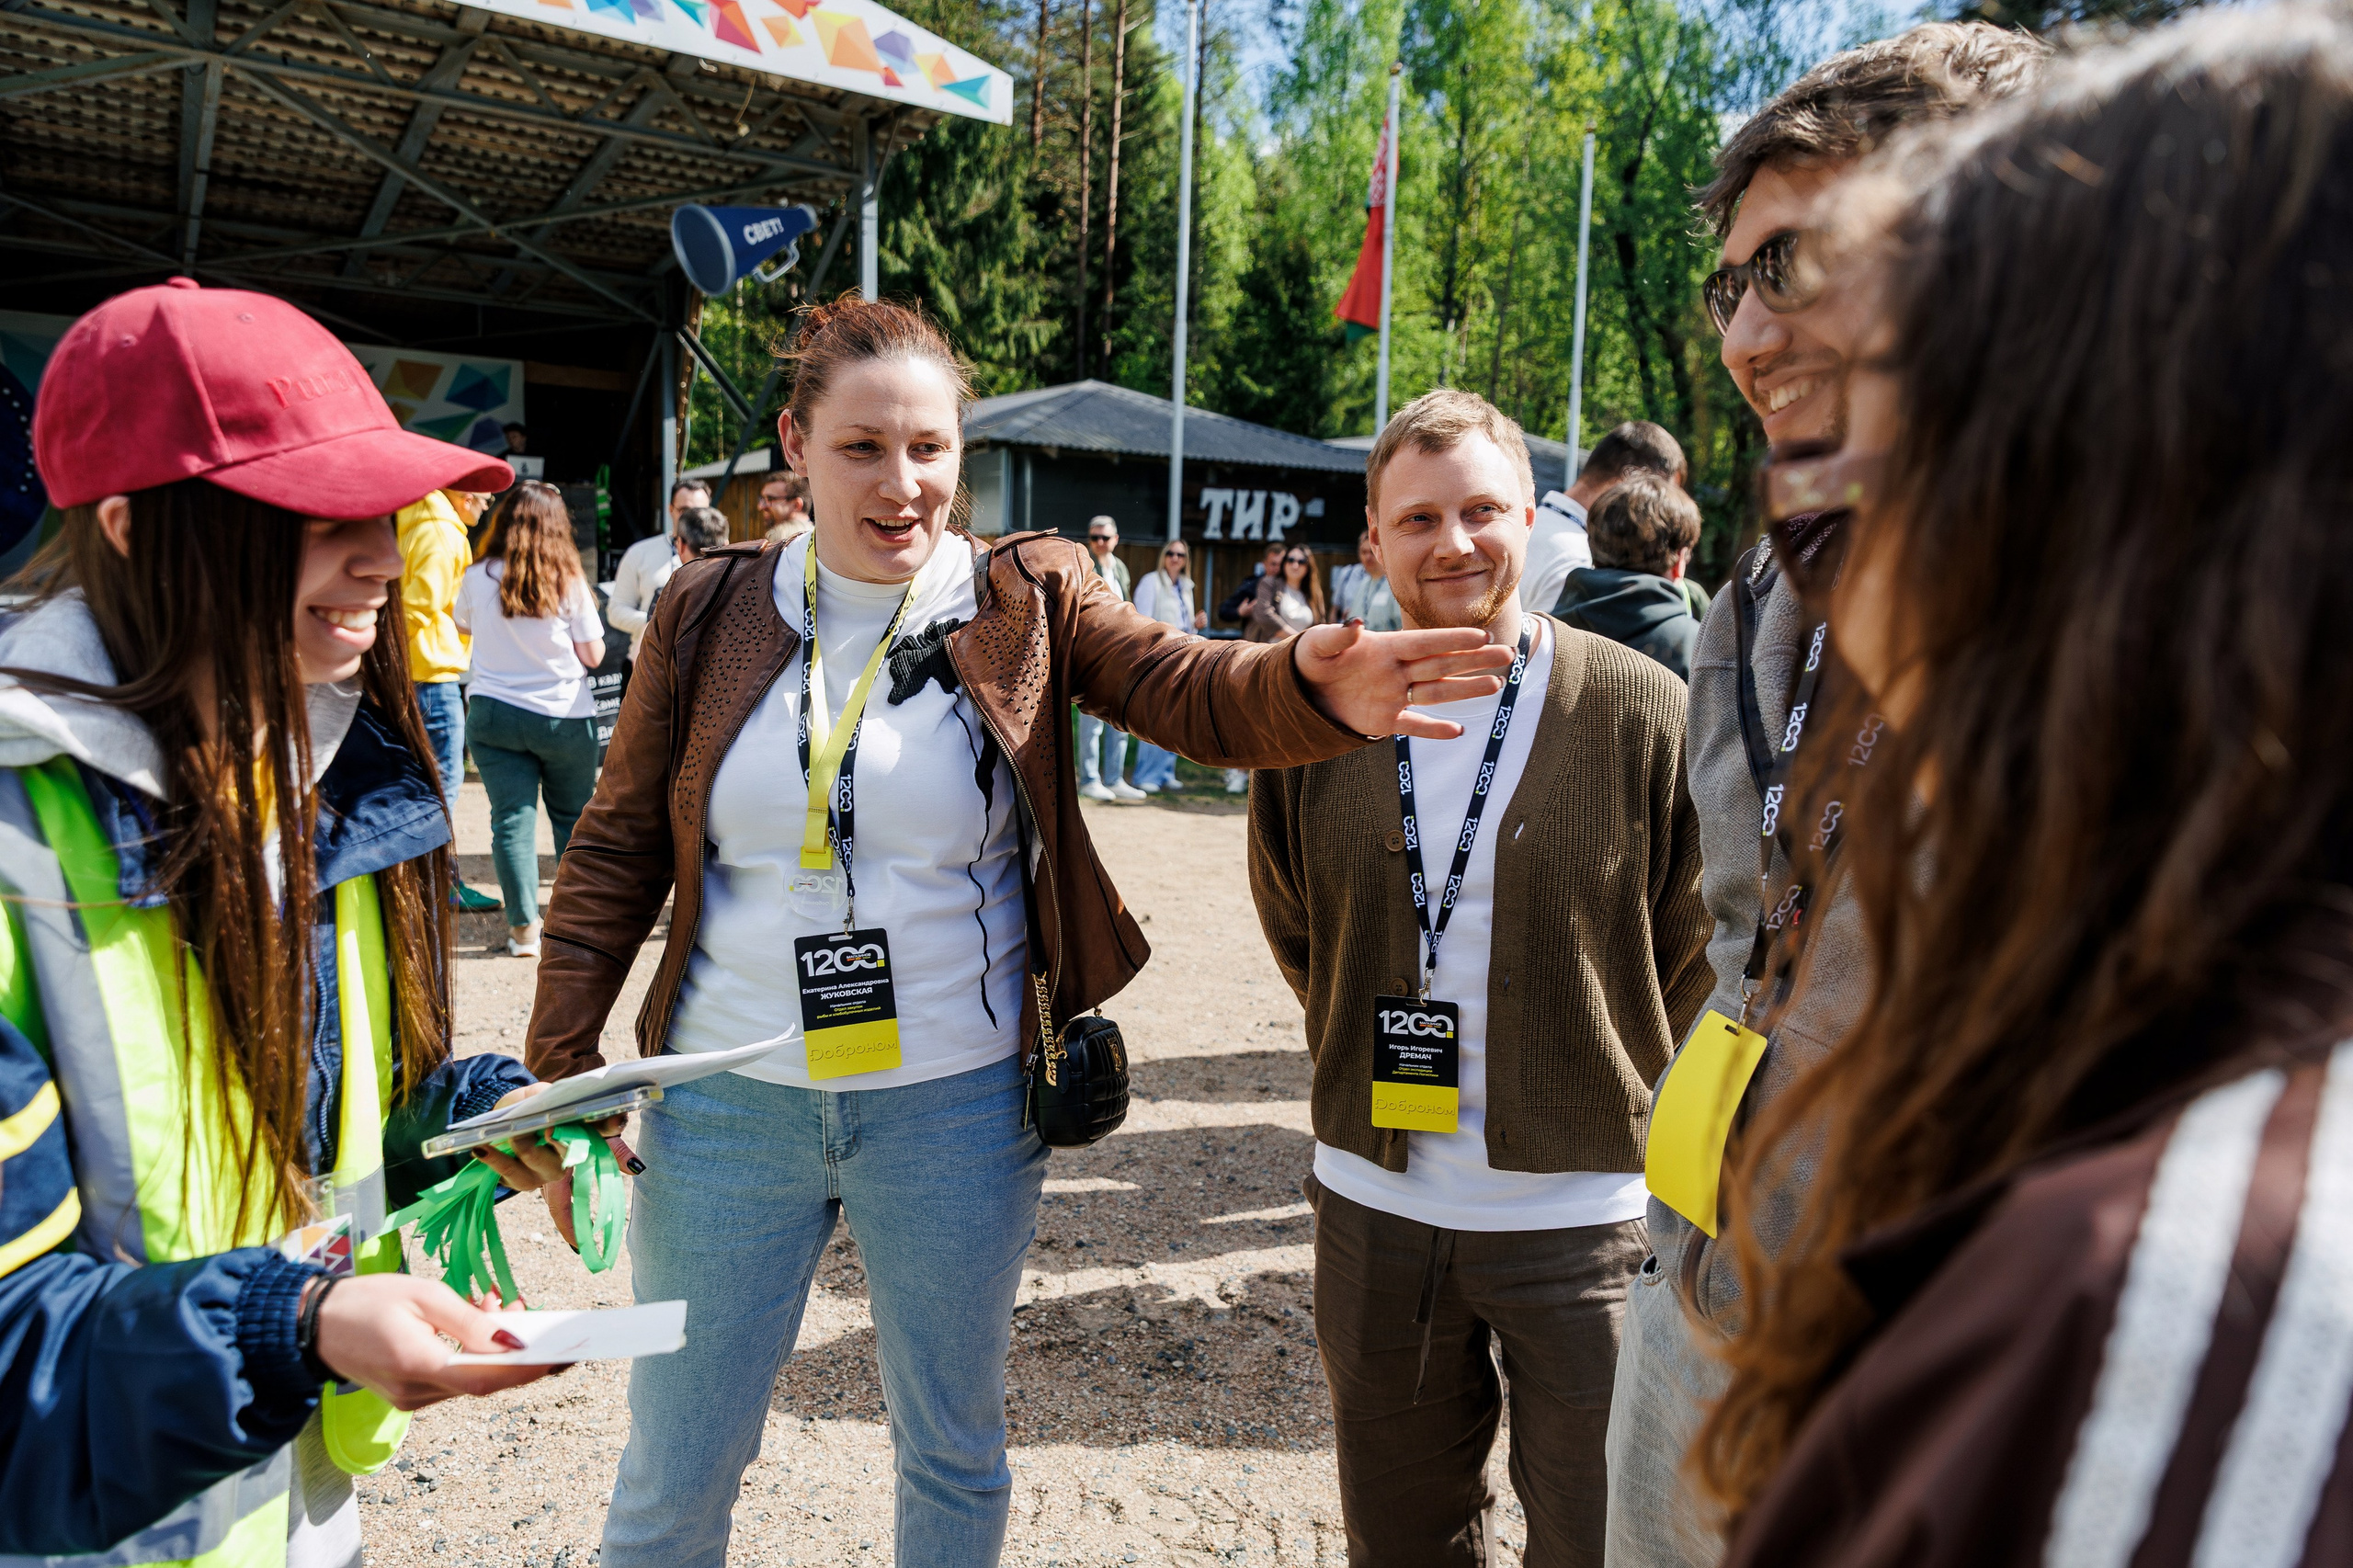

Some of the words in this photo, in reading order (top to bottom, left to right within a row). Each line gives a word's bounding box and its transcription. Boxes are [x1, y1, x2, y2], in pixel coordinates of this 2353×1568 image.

[743, 217, 785, 246] СВЕТ!
[1199, 486, 1301, 542] ТИР
[800, 943, 886, 978] 1200
[801, 984, 837, 995] Екатерина
[837, 978, 890, 990] Александровна
[820, 987, 873, 1001] ЖУКОВСКАЯ
[1378, 1009, 1455, 1039] 1200
[1389, 1043, 1409, 1051] Игорь
[1410, 1045, 1443, 1054] Игоревич
[1399, 1051, 1432, 1061] ДРЕМАЧ
